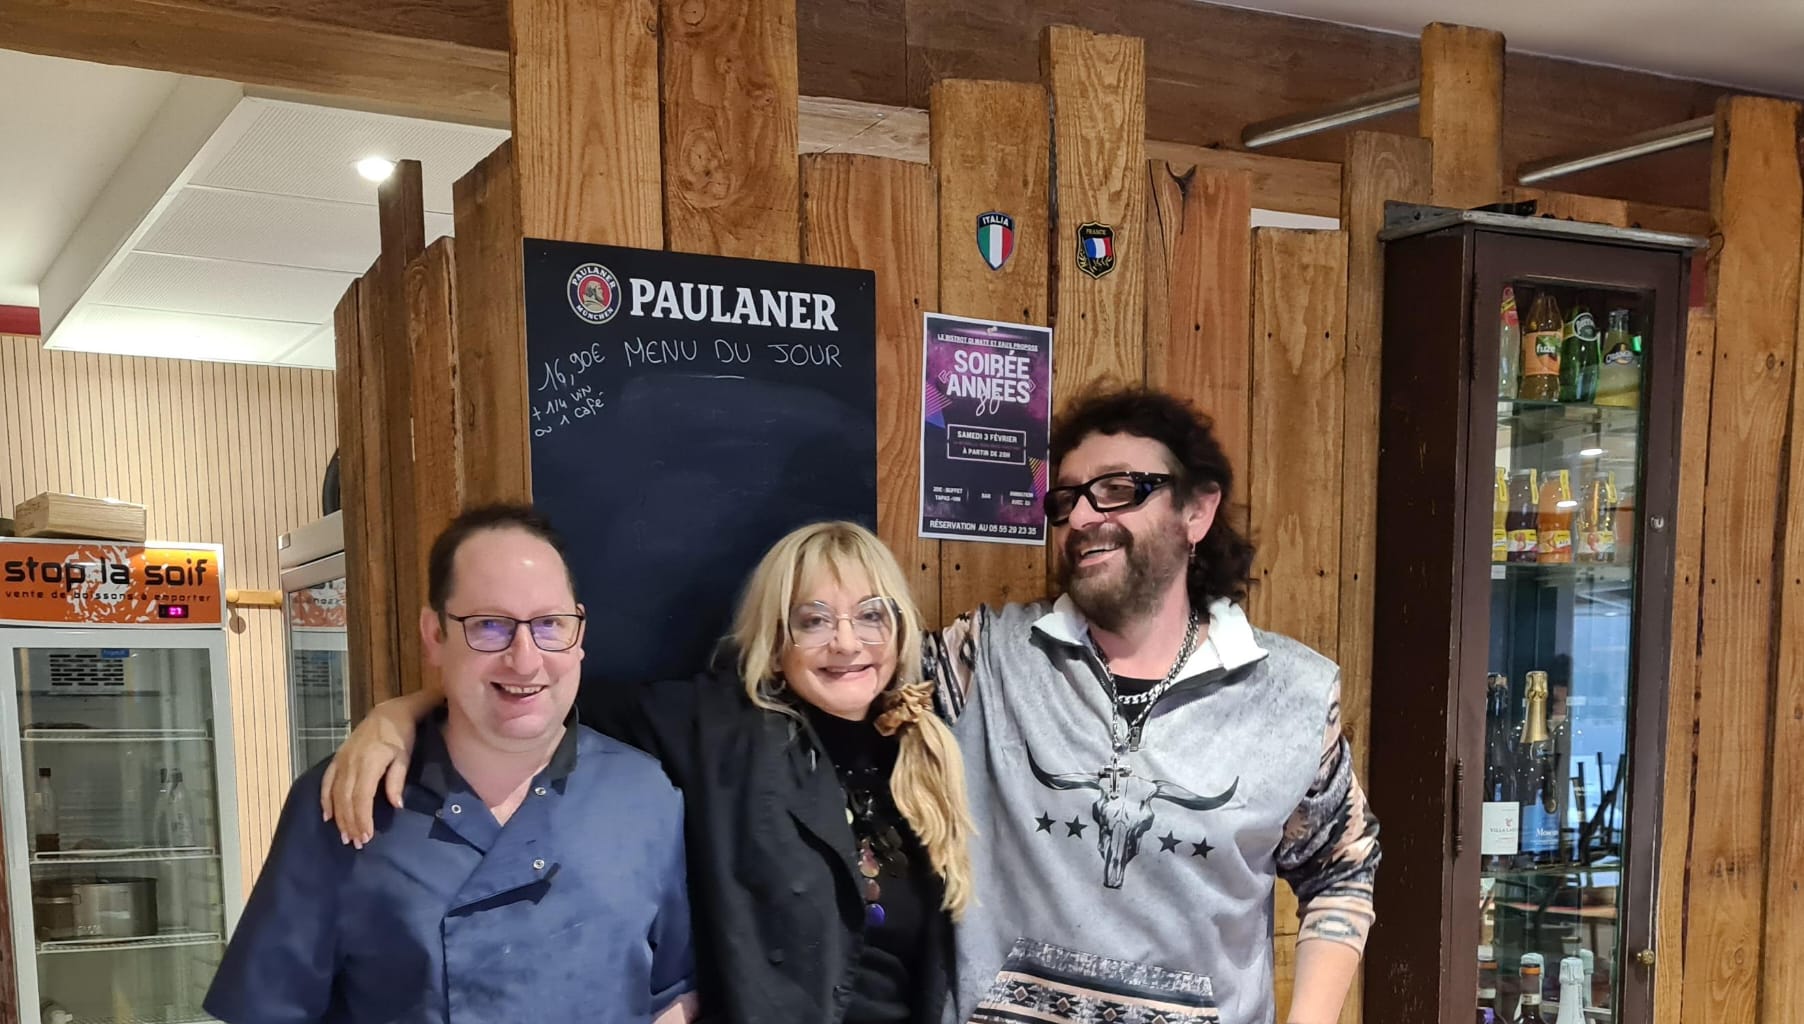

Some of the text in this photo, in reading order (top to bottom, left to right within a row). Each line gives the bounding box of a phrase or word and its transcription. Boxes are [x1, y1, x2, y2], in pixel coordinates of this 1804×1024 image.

[982, 215, 1009, 226] ITALIA
[572, 266, 616, 288] PAULANER
[629, 278, 839, 331] PAULANER
[624, 337, 842, 367] MENU DU JOUR
[954, 350, 1030, 379] SOIRÉE
[946, 372, 1031, 404] ANNÉES
[957, 430, 983, 440] SAMEDI
[990, 432, 1017, 443] FÉVRIER
[930, 519, 976, 531] RÉSERVATION
[978, 524, 988, 532] AU
[989, 524, 998, 532] 05
[4, 556, 209, 593] stop la soif
[5, 589, 44, 599] vente
[51, 589, 67, 599] de
[74, 590, 134, 600] boissons
[154, 593, 212, 604] emporter
